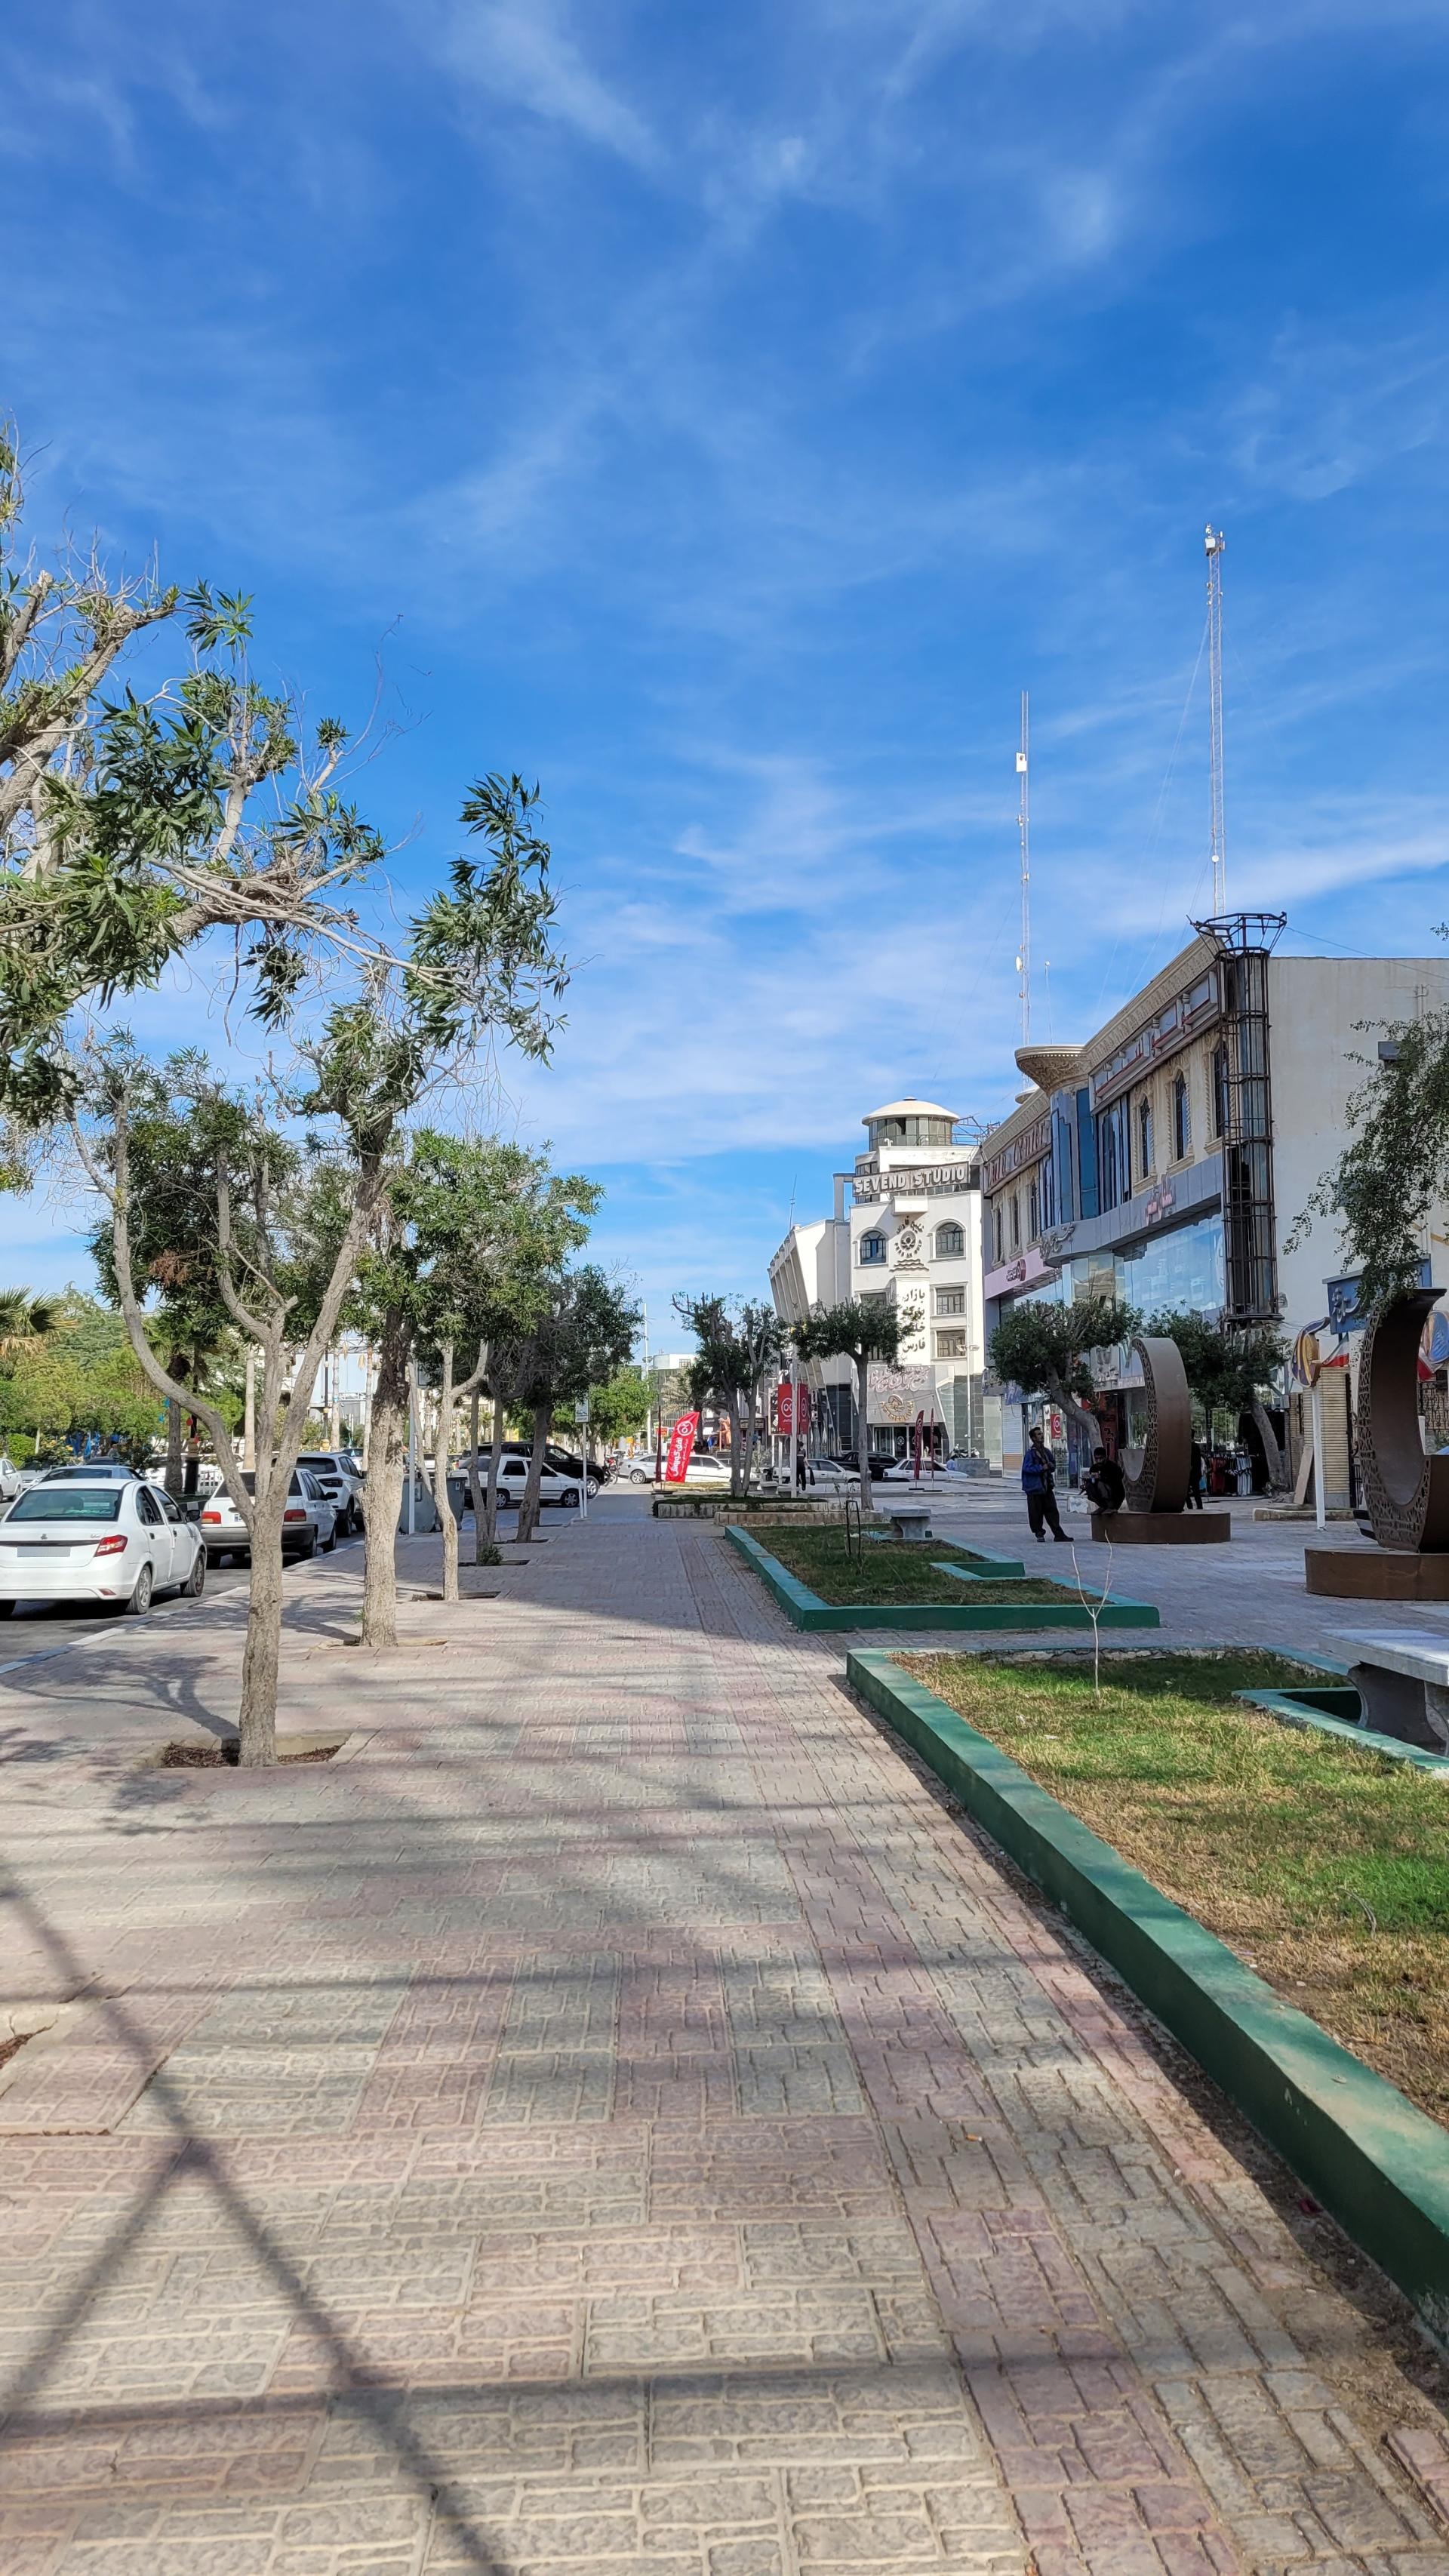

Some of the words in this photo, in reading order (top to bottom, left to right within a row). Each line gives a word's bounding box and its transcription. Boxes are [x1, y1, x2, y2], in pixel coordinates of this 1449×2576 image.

[854, 1174, 906, 1194] SEVEND
[914, 1166, 965, 1187] STUDIO
[904, 1288, 925, 1303] بازار
[903, 1337, 925, 1353] فارس
